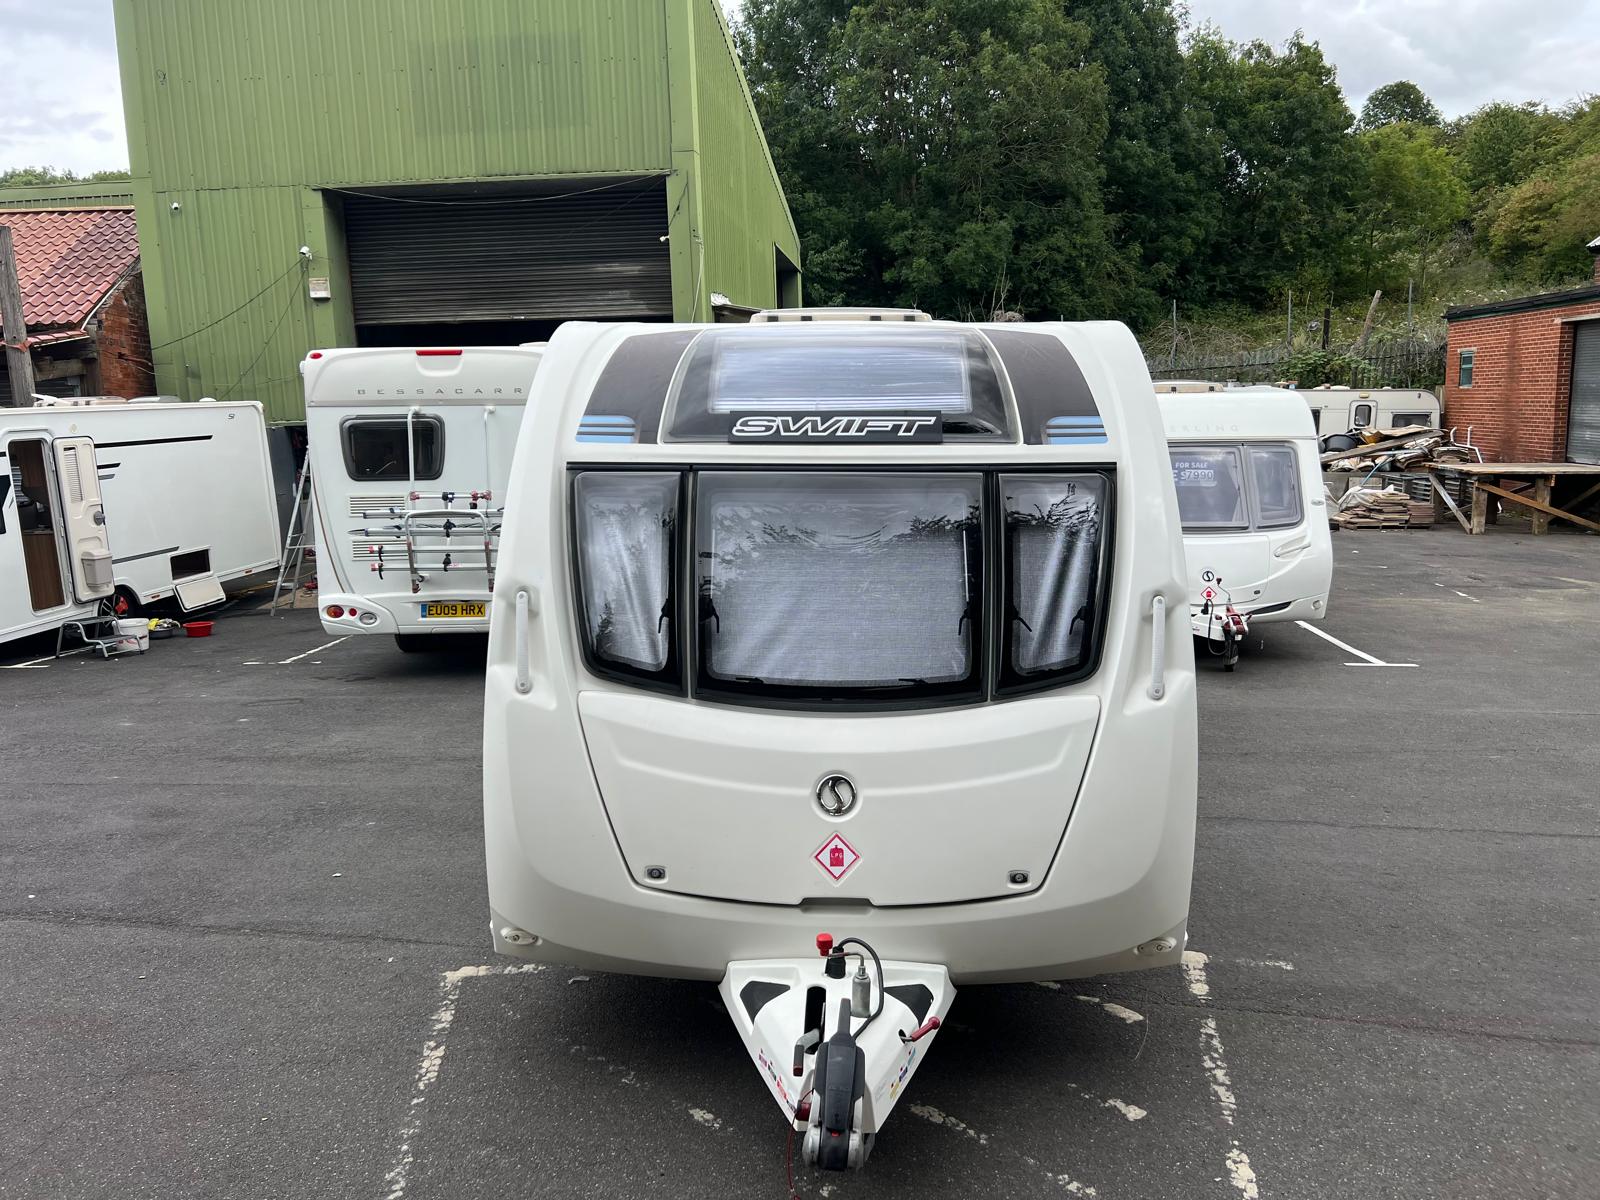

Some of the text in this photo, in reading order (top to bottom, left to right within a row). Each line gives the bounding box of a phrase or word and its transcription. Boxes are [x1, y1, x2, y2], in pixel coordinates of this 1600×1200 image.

[356, 386, 524, 396] BESSACARR
[731, 415, 937, 437] SWIFT
[428, 605, 484, 616] EU09 HRX
